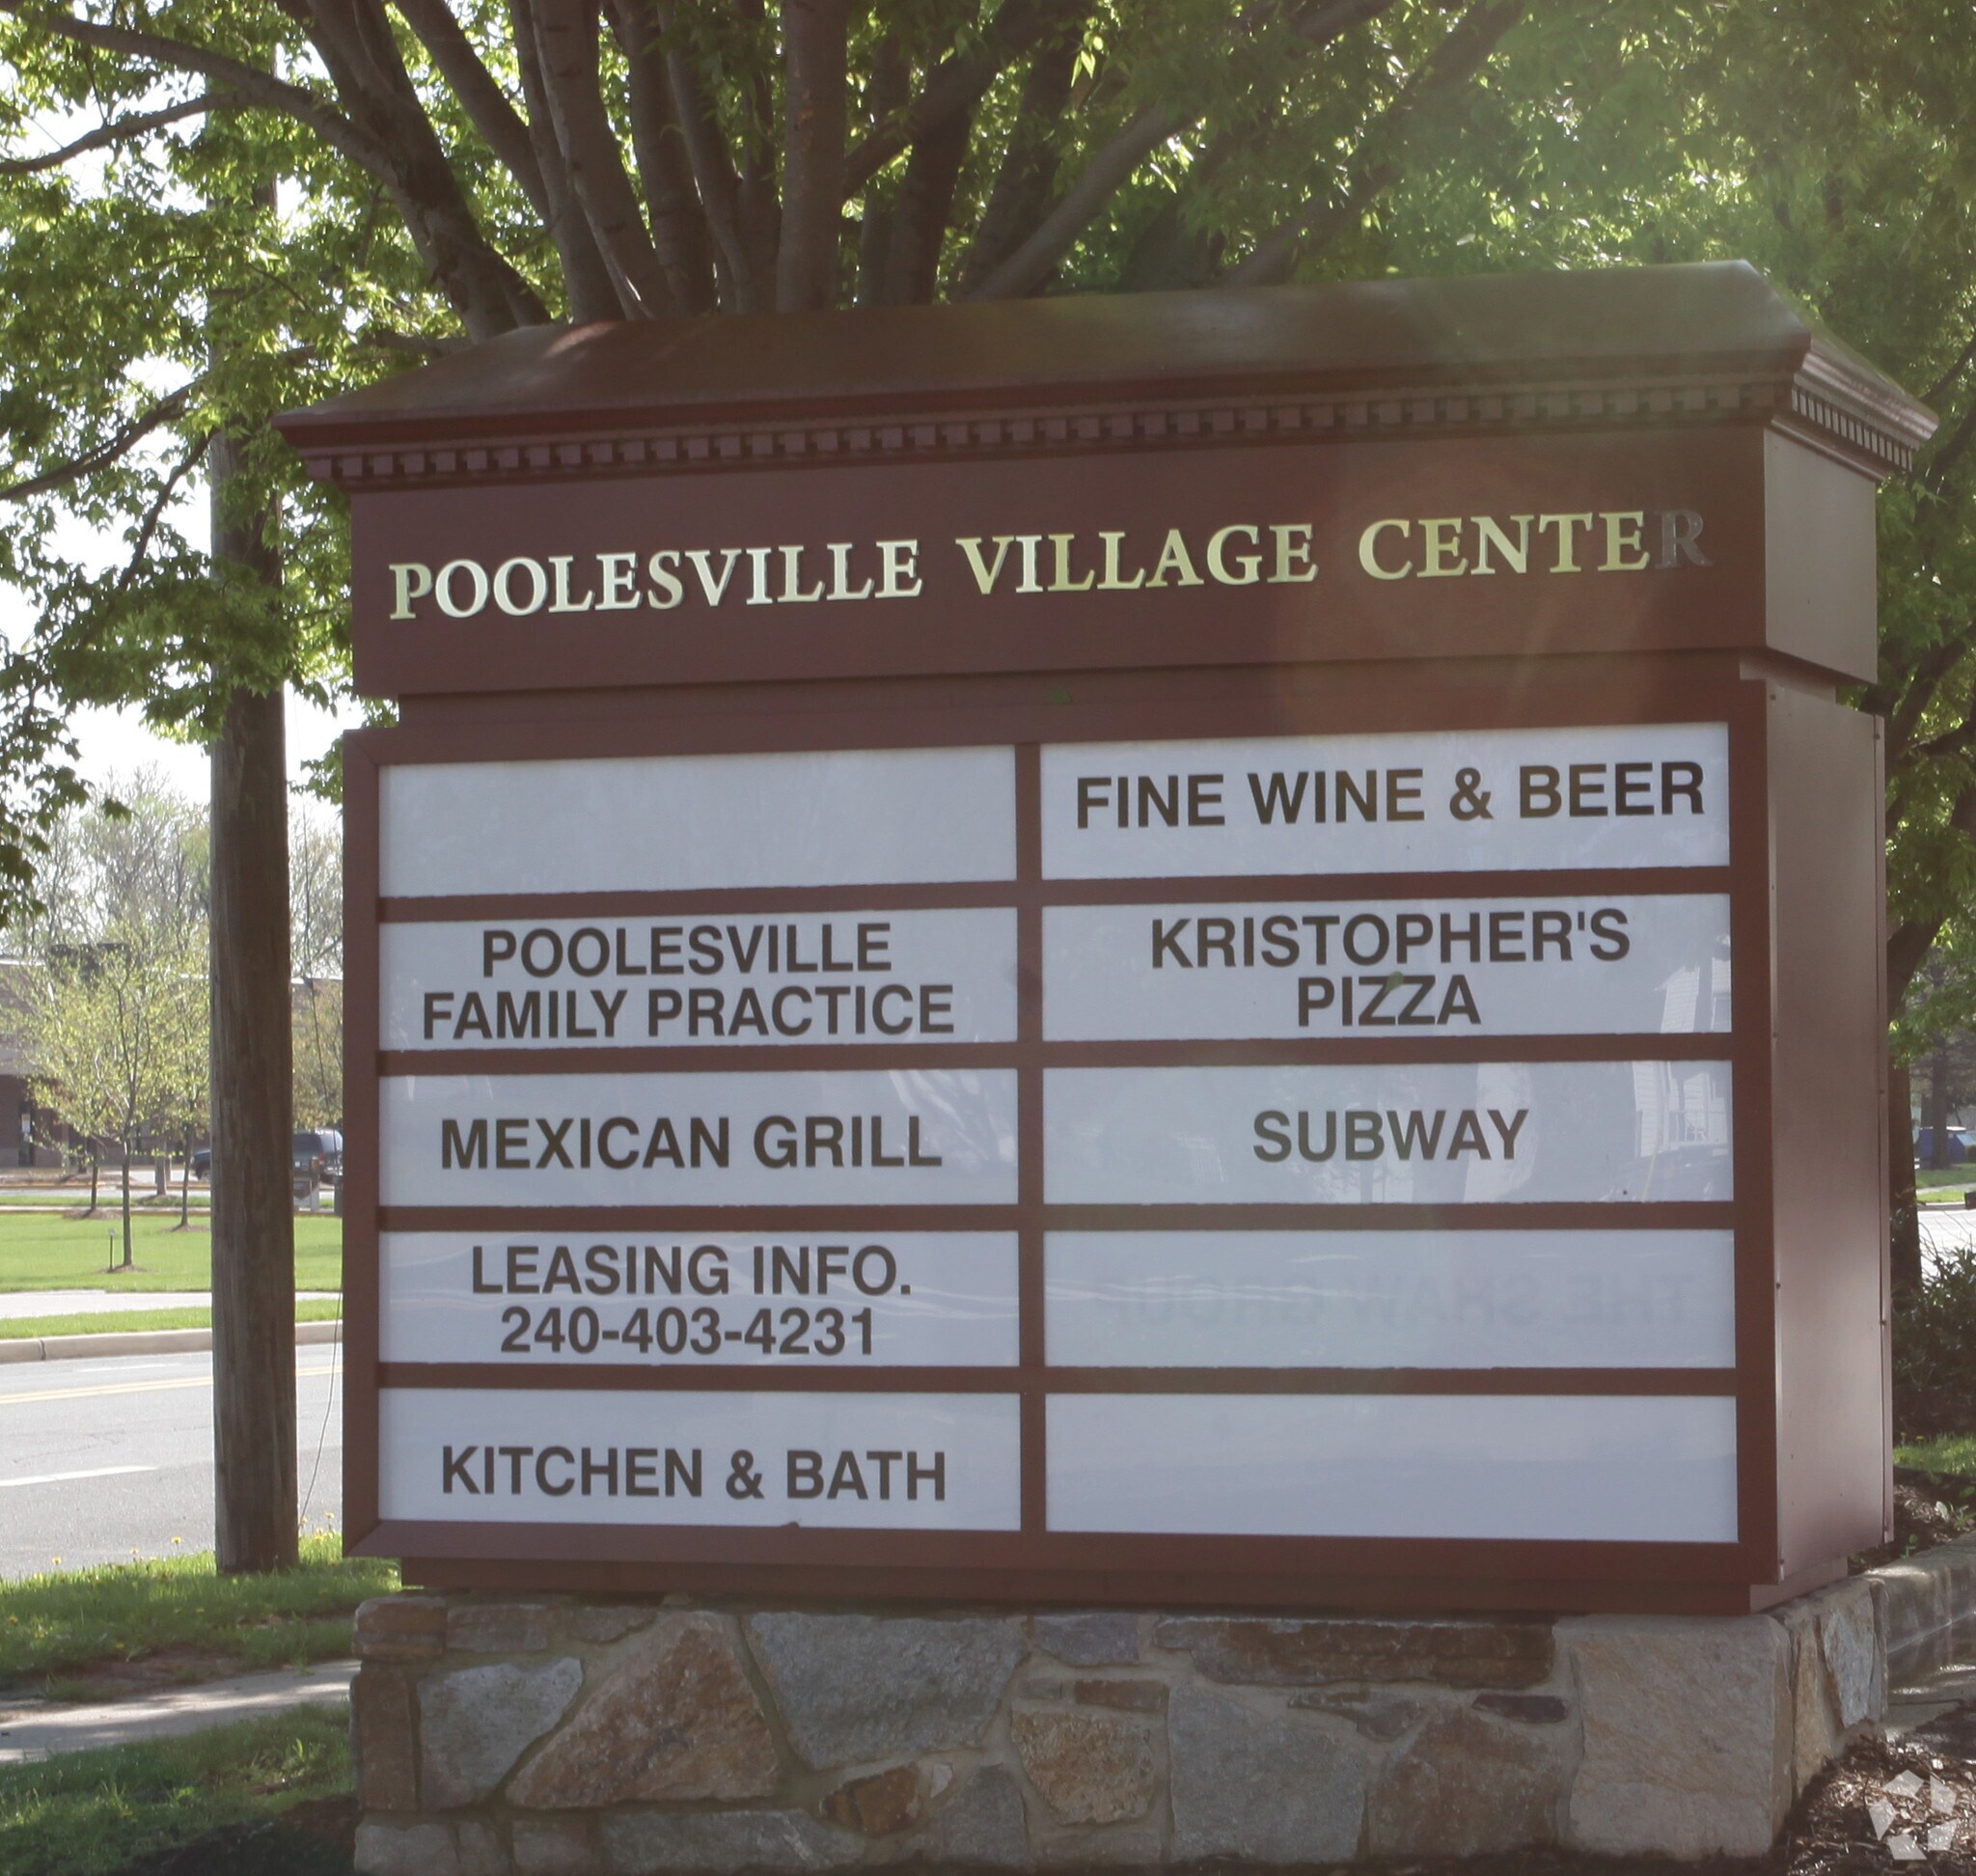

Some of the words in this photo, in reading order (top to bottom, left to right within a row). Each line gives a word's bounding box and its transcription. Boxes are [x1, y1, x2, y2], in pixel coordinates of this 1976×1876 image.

[390, 539, 922, 619] POOLESVILLE
[955, 524, 1317, 593] VILLAGE
[1358, 509, 1714, 579] CENTER
[1078, 774, 1224, 828] FINE
[1248, 769, 1424, 824] WINE
[1450, 767, 1493, 820] &
[1520, 761, 1704, 817] BEER
[481, 923, 892, 978] POOLESVILLE
[1153, 908, 1630, 968] KRISTOPHER'S
[425, 990, 627, 1039] FAMILY
[648, 984, 953, 1036] PRACTICE
[1299, 972, 1481, 1027] PIZZA
[442, 1117, 728, 1170] MEXICAN
[754, 1116, 942, 1169] GRILL
[1253, 1110, 1528, 1162] SUBWAY
[473, 1245, 728, 1295] LEASING
[754, 1245, 910, 1295] INFO.
[501, 1306, 871, 1356] 240-403-4231
[443, 1446, 701, 1497] KITCHEN
[726, 1449, 764, 1500] &
[787, 1450, 945, 1501] BATH
